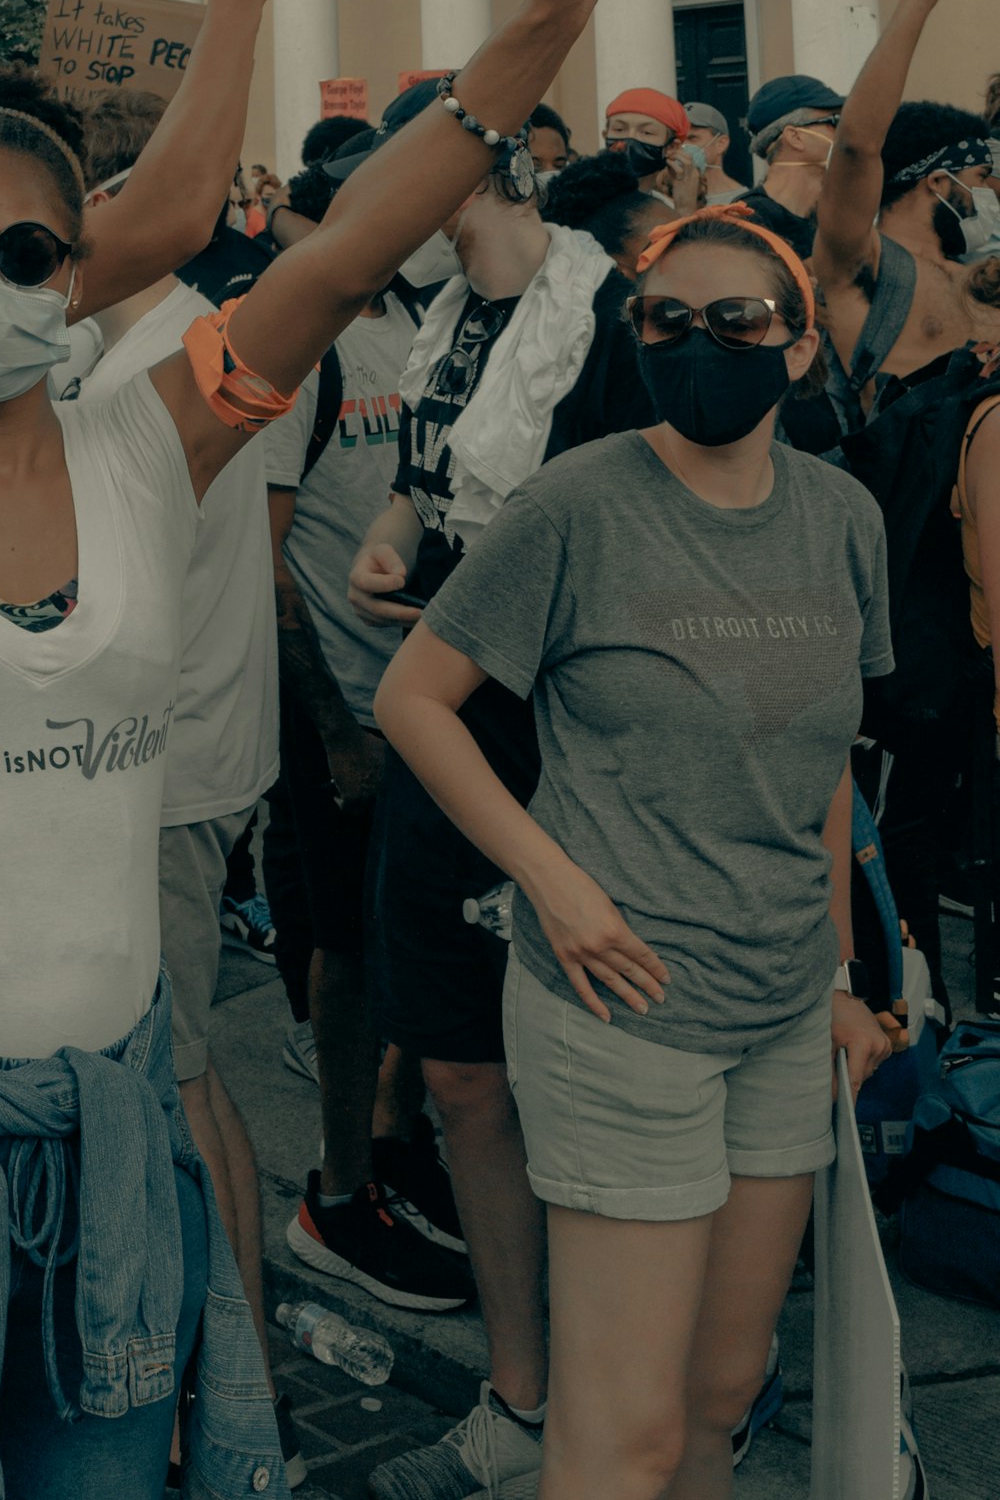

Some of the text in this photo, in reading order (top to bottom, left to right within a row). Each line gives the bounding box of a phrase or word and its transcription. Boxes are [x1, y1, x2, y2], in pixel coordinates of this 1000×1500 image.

[94, 3, 147, 34] takes
[53, 27, 138, 59] WHITE
[52, 57, 135, 87] TO STOP
[672, 615, 838, 641] DETROIT CITY FC
